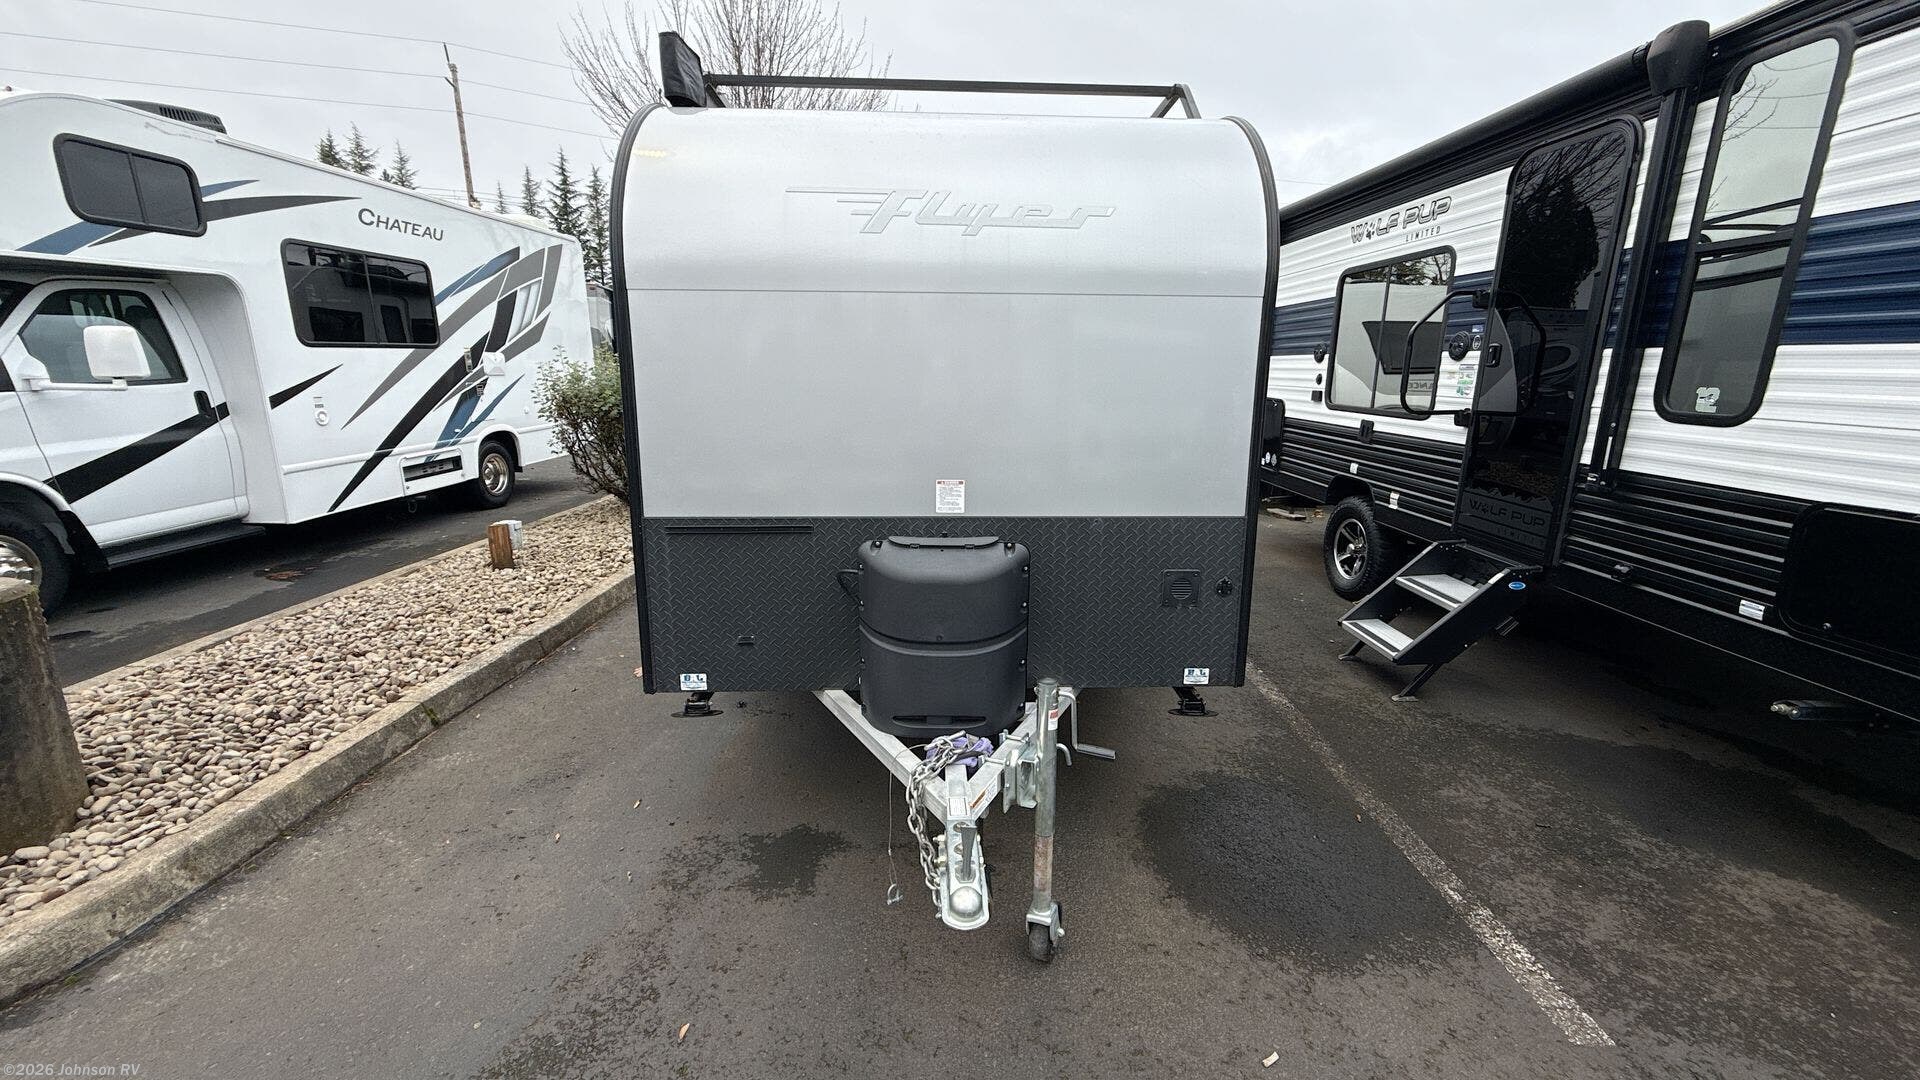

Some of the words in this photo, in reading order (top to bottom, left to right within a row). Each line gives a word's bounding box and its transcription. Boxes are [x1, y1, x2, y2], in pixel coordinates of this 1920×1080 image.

[357, 208, 444, 241] CHATEAU
[785, 187, 1116, 236] Flyer
[1402, 196, 1452, 229] PUP
[1405, 226, 1441, 242] LIMITED
[1511, 510, 1545, 527] PUP
